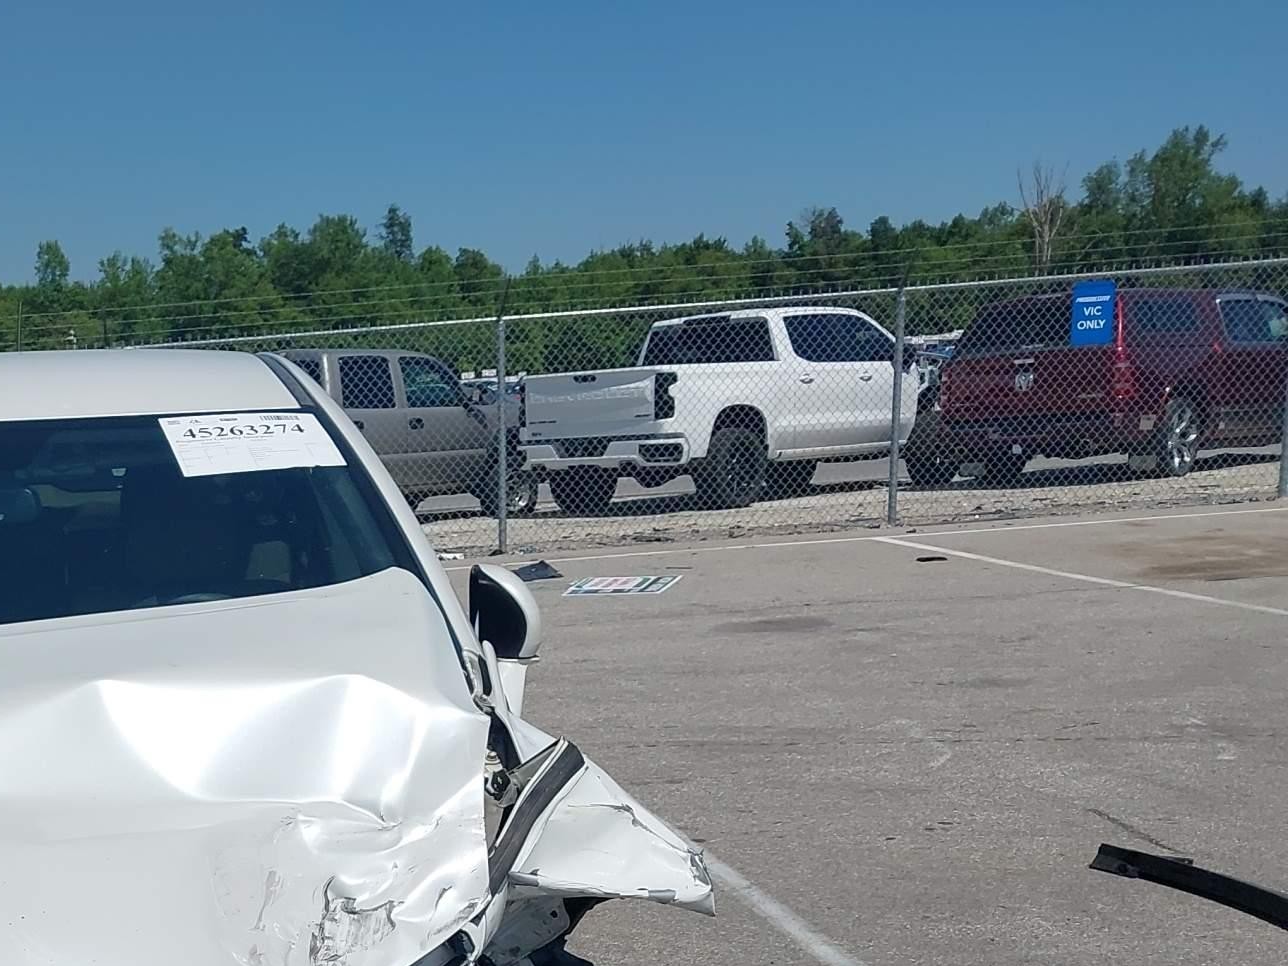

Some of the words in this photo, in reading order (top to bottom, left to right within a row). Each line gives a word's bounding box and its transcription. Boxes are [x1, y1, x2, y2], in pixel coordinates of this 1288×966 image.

[1083, 306, 1102, 316] VIC
[1077, 319, 1106, 330] ONLY
[183, 423, 305, 439] 45263274
